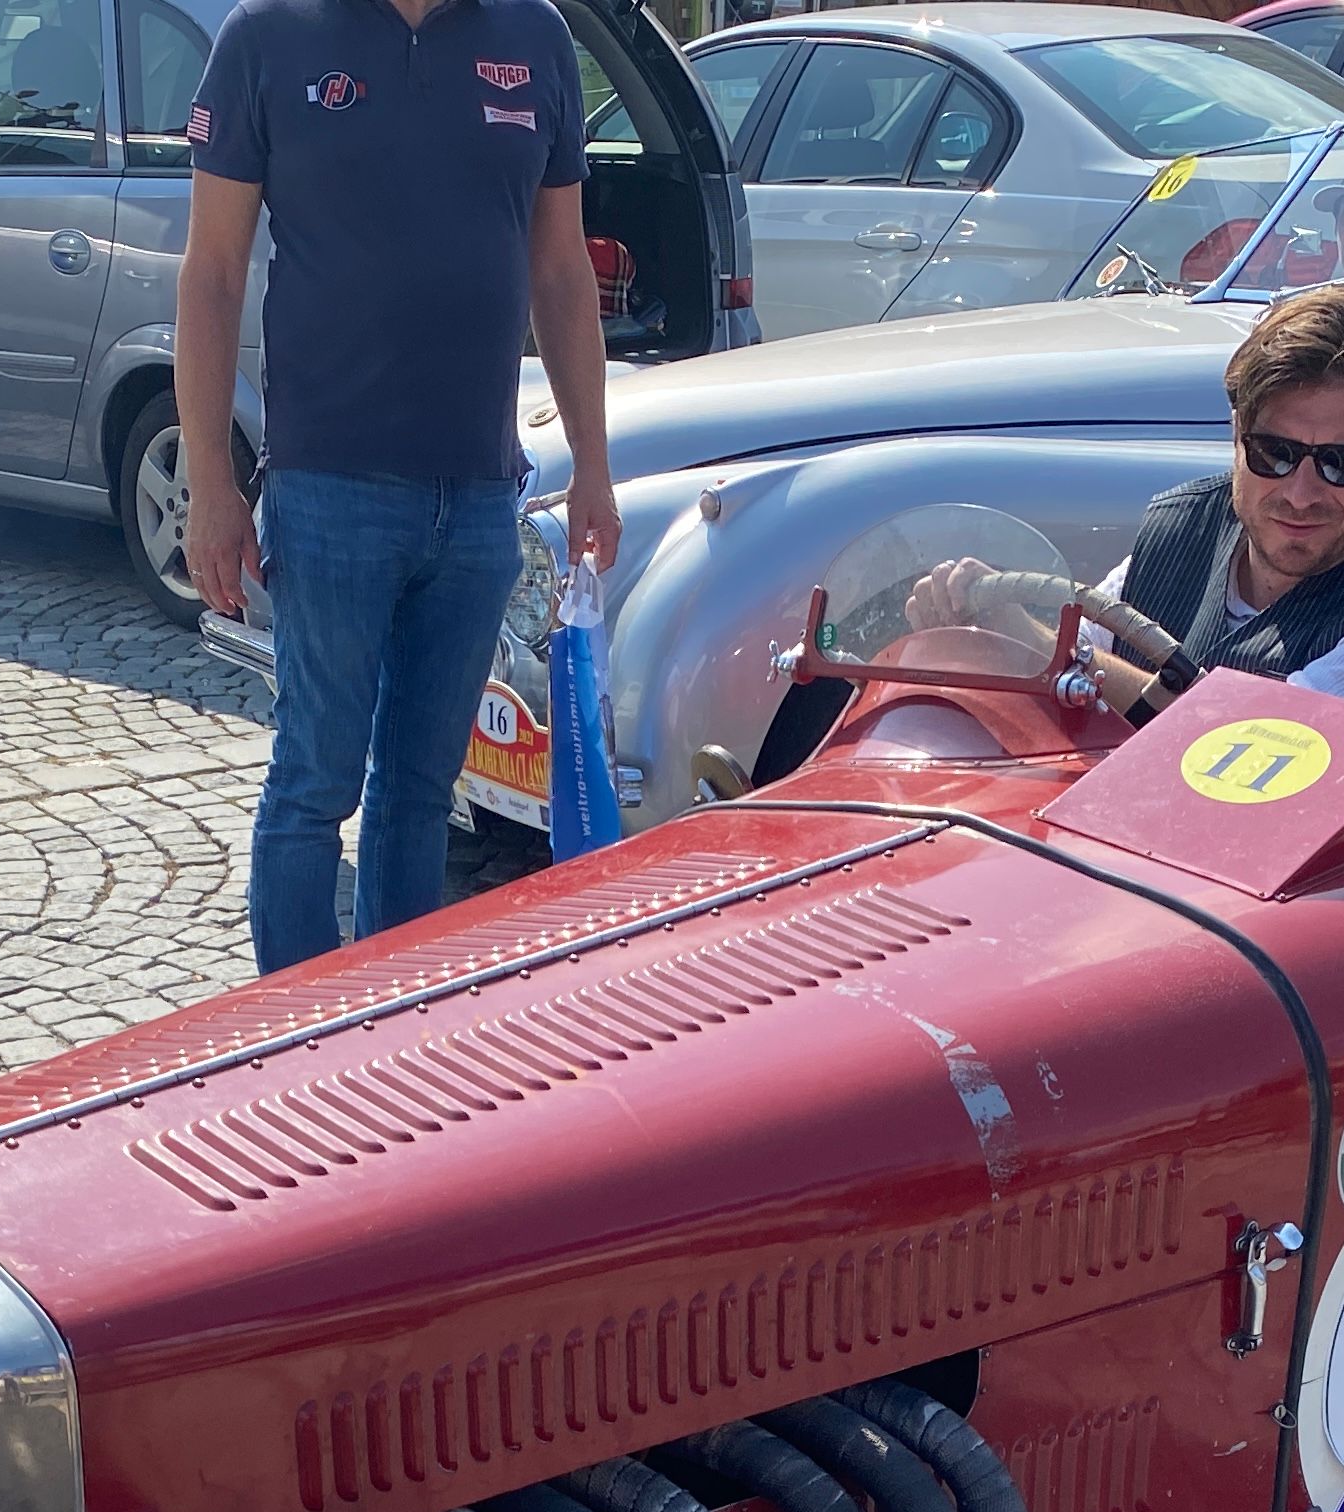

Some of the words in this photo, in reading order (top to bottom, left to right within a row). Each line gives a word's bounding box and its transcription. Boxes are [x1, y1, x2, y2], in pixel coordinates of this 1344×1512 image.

[479, 63, 527, 87] HILFIGER
[822, 624, 833, 648] 105
[488, 701, 508, 735] 16
[1194, 743, 1297, 794] 11
